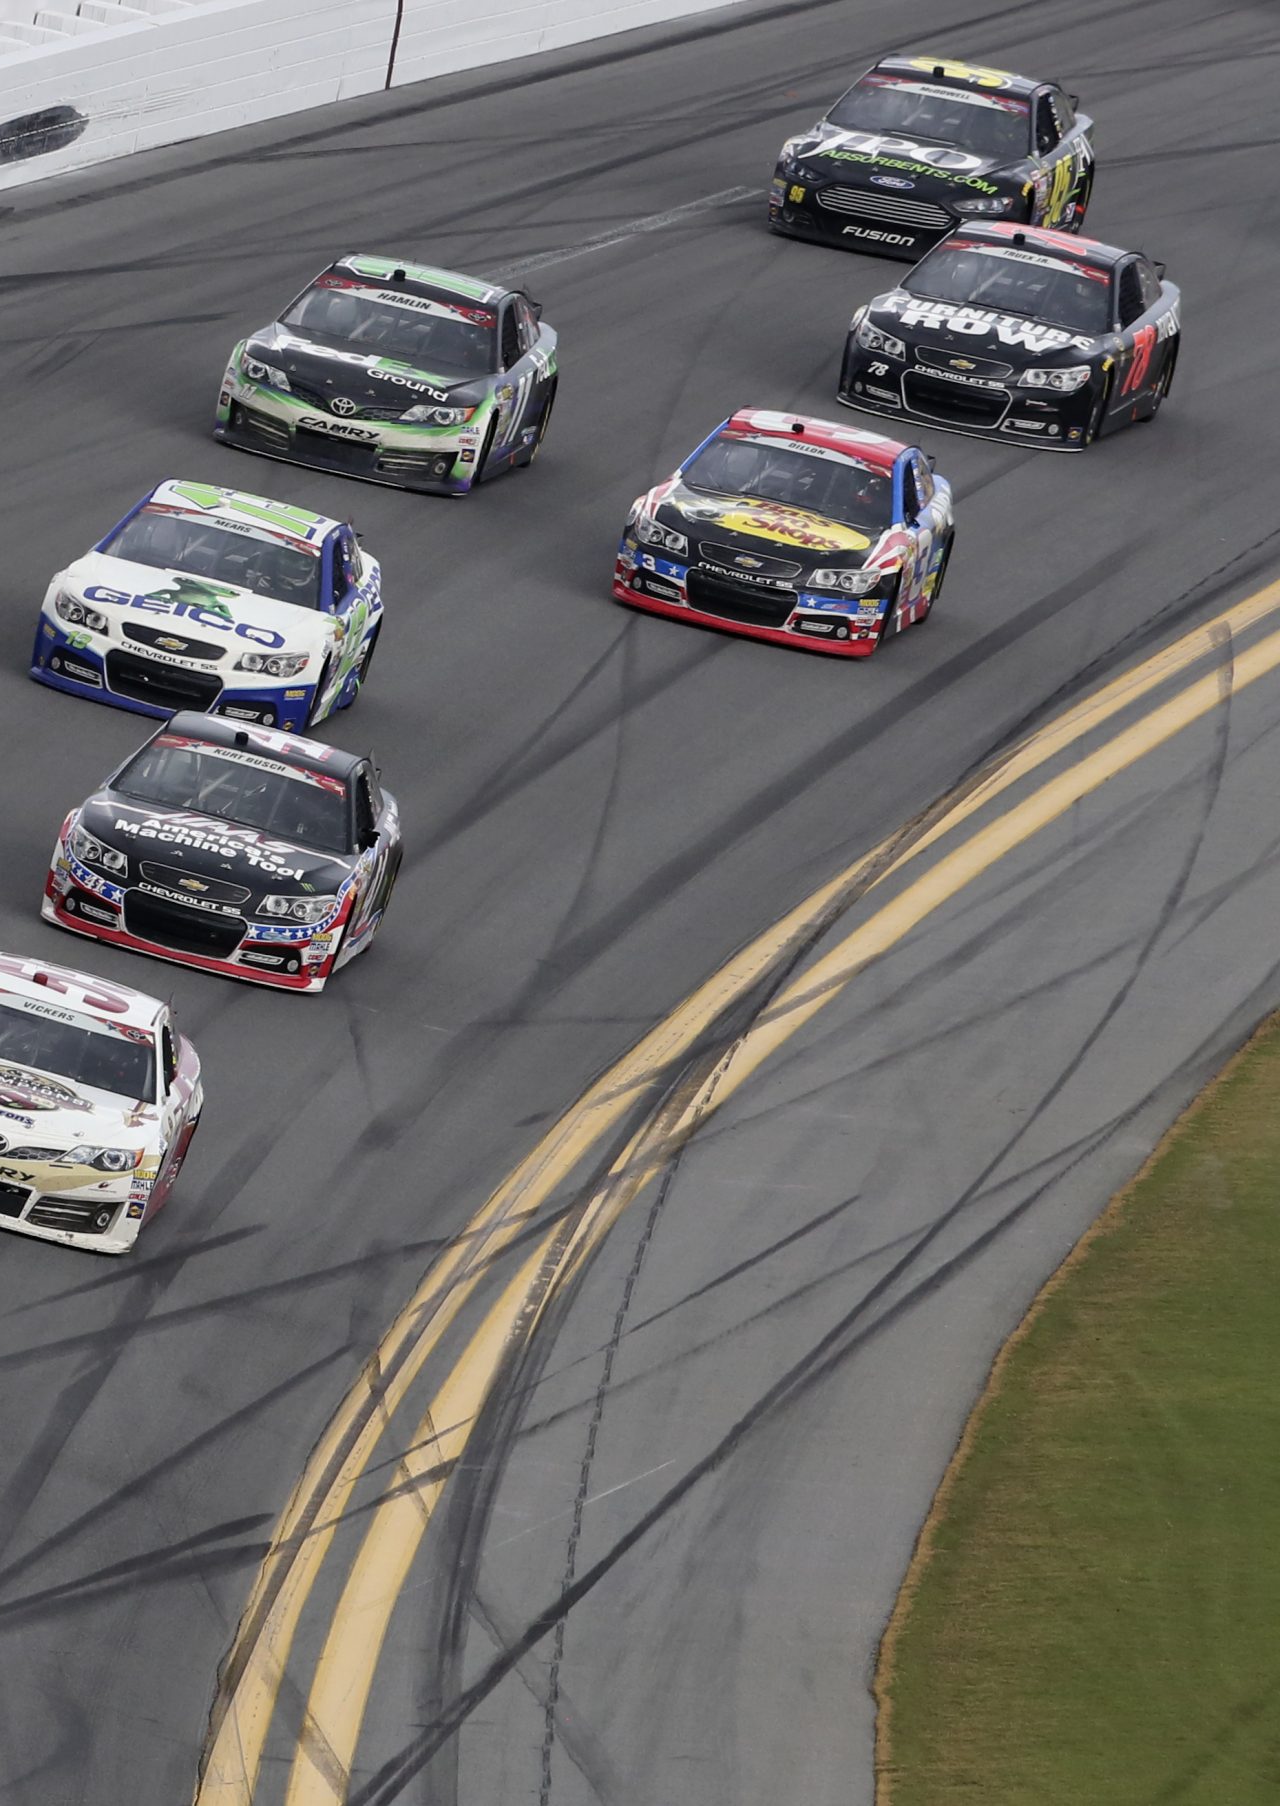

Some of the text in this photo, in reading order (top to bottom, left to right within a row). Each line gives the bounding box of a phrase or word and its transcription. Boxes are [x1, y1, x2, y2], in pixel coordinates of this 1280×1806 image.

[819, 149, 999, 196] ABSORBENTS.COM
[789, 185, 806, 203] 95
[842, 225, 915, 247] FUSION
[376, 292, 432, 311] HAMLIN
[882, 296, 1096, 352] FURNITURE
[899, 310, 1059, 353] ROW
[866, 361, 890, 377] 78
[914, 364, 1006, 389] CHEVROLET SS
[239, 383, 258, 400] 11
[366, 368, 450, 403] Ground
[298, 416, 382, 441] CAMRY
[787, 442, 826, 456] DILLON
[214, 519, 253, 534] MEARS
[756, 500, 833, 528] Bass
[742, 515, 842, 551] Shops
[641, 552, 656, 572] 3
[697, 561, 794, 589] CHEVROLET SS
[83, 586, 286, 649] GEICO
[65, 630, 93, 649] 13
[121, 641, 219, 672] CHEVROLET SS
[213, 748, 287, 773] KURT BUSCH
[114, 819, 305, 881] Machine Tool
[141, 819, 286, 865] America's
[138, 881, 242, 916] CHEVROLET SS
[23, 1001, 76, 1022] VICKERS
